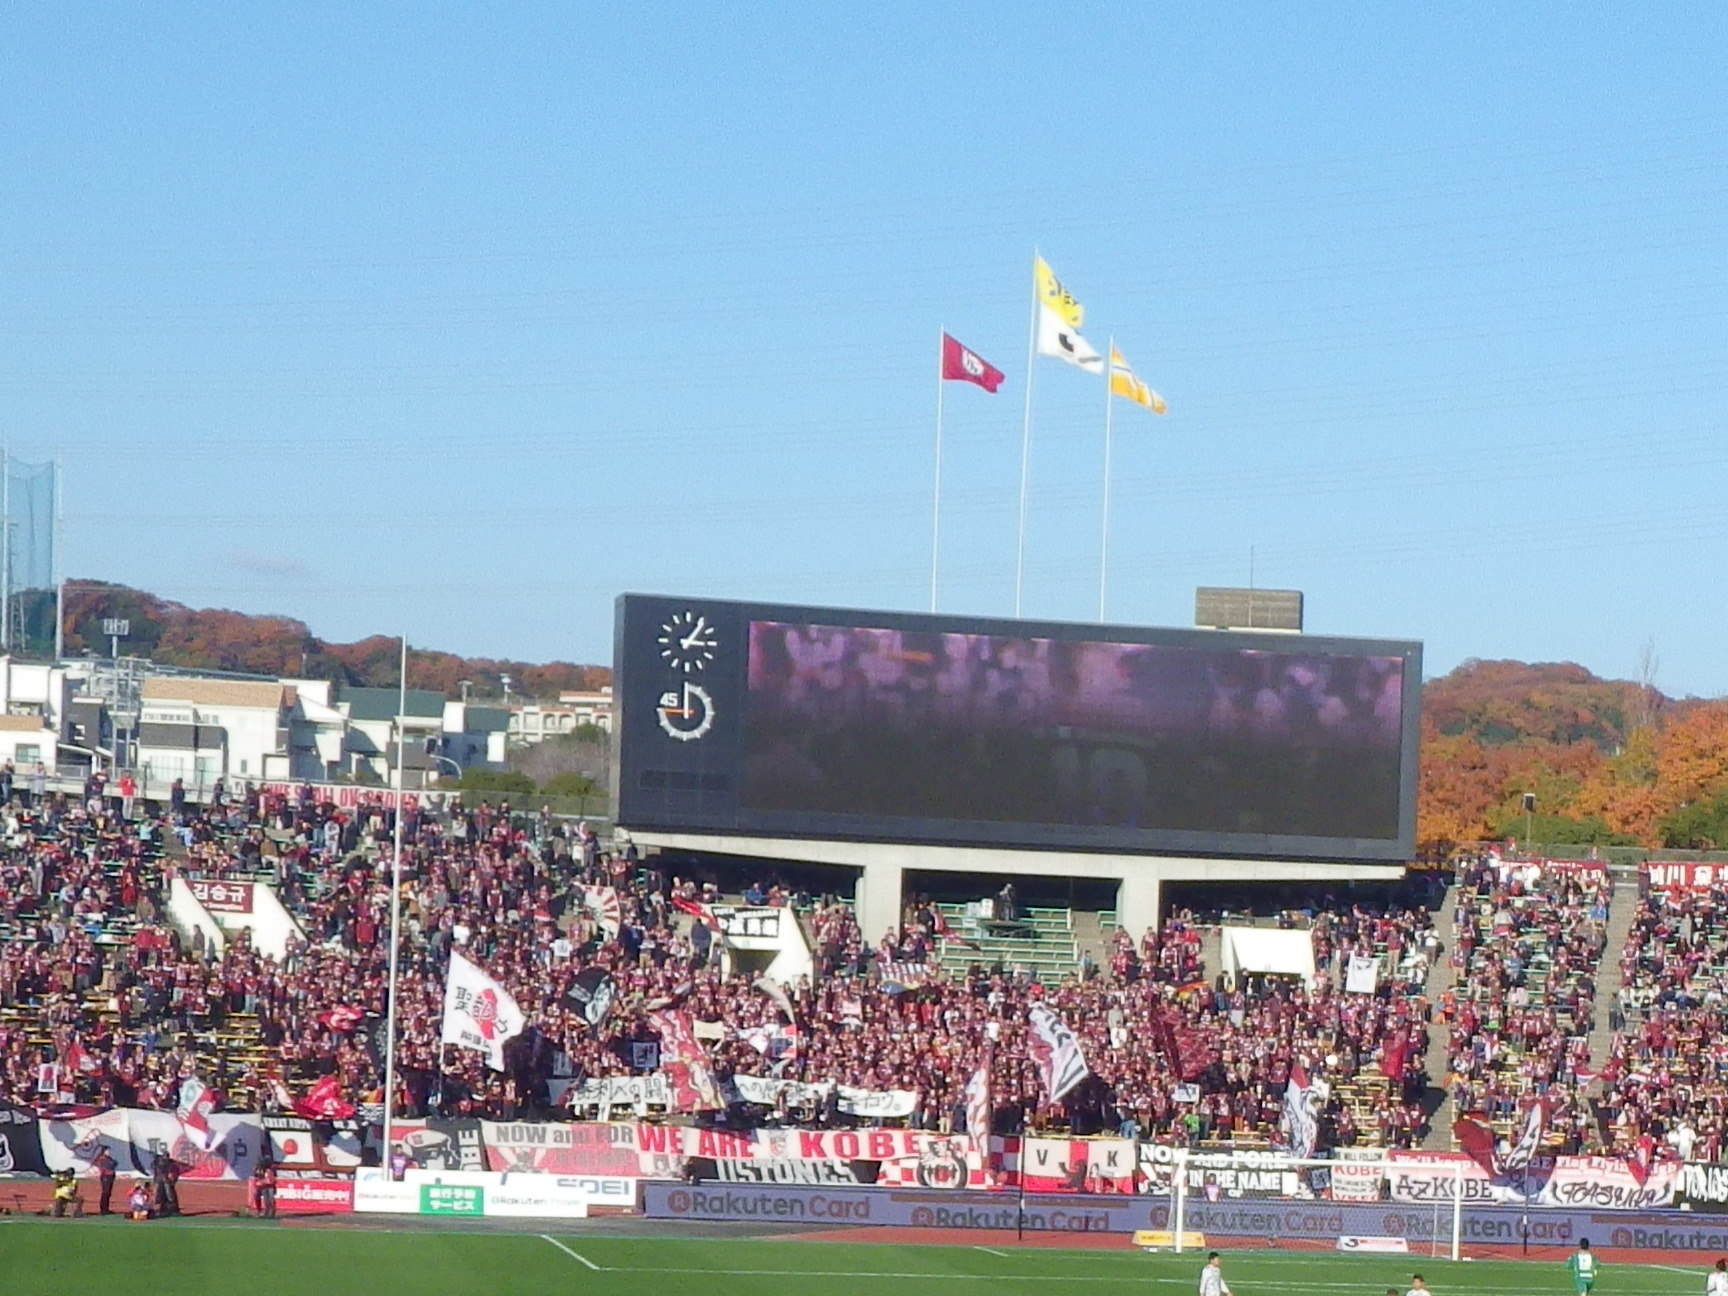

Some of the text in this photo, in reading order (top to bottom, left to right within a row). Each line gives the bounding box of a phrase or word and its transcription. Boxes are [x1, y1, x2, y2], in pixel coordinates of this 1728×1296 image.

[660, 692, 678, 707] 45
[496, 1124, 547, 1144] NOW
[553, 1126, 588, 1143] and
[636, 1124, 921, 1160] WE ARE KOBE
[1036, 1149, 1118, 1167] V K
[1140, 1144, 1188, 1164] NOW
[1190, 1170, 1204, 1187] IN
[1238, 1171, 1280, 1190] NAME
[692, 1191, 870, 1219] Rakuten Card
[935, 1208, 1109, 1231] Rakuten Card
[1284, 1210, 1344, 1233] Card
[1515, 1217, 1573, 1240] Card
